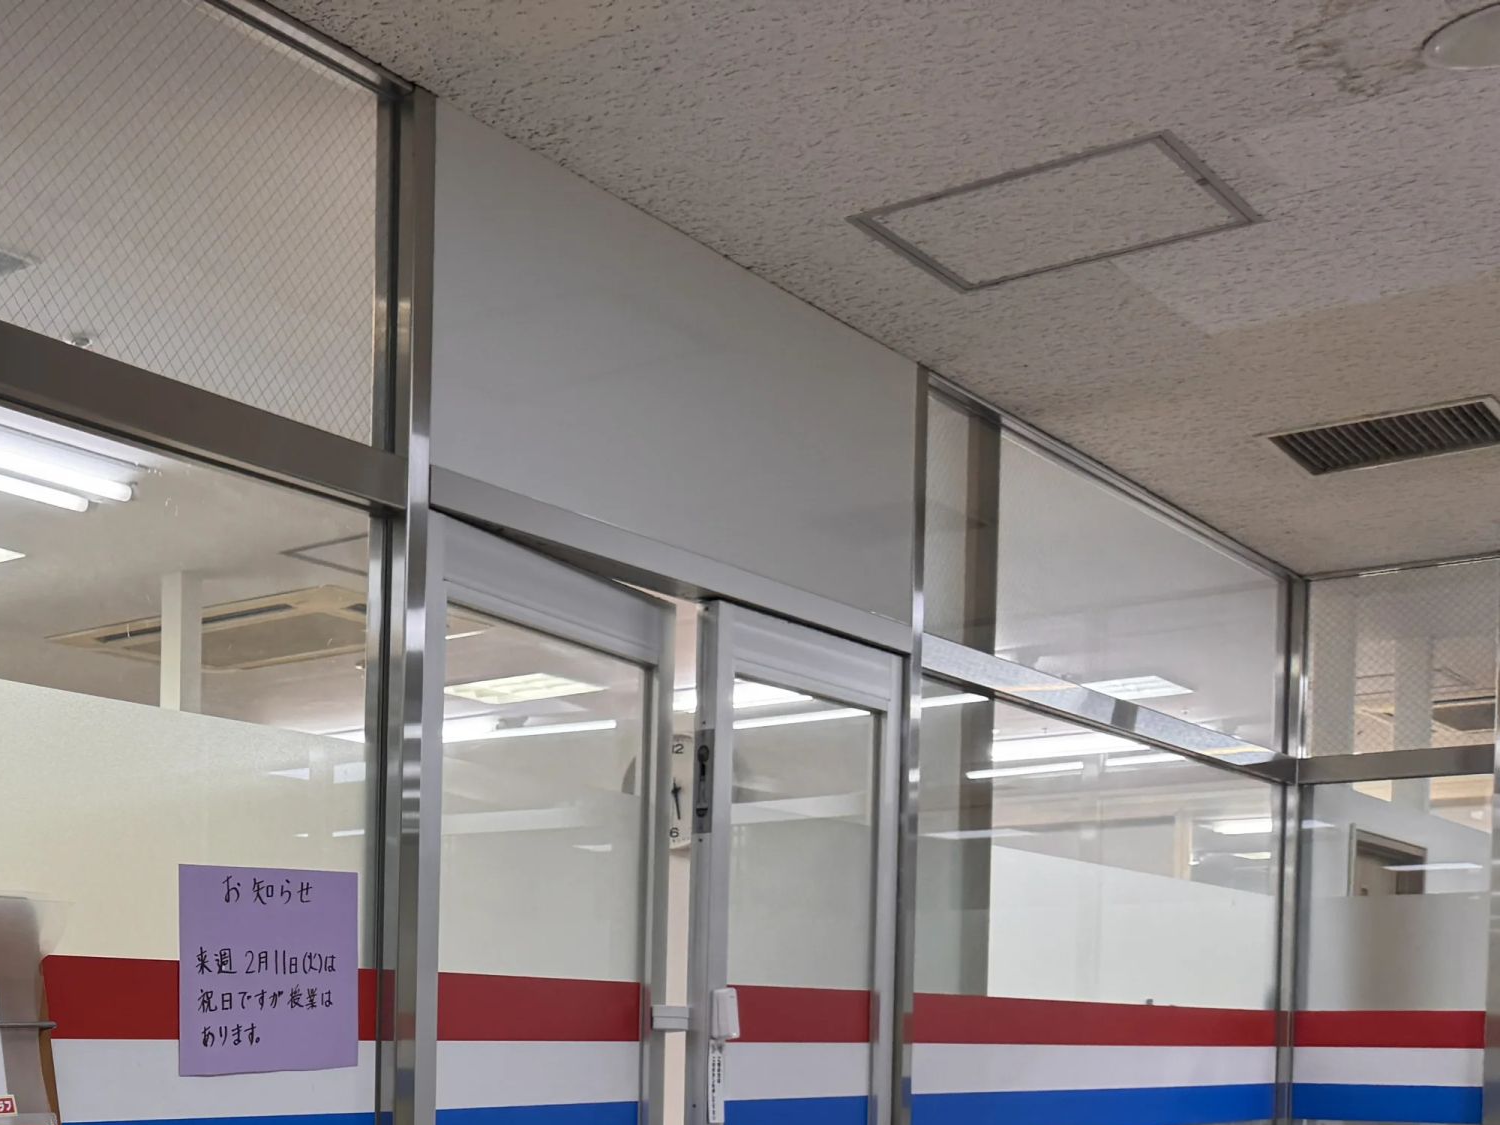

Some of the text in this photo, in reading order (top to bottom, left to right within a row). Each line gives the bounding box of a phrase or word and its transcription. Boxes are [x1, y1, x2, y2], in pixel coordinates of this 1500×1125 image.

[222, 876, 312, 905] お知らせ
[201, 1023, 261, 1047] あります。
